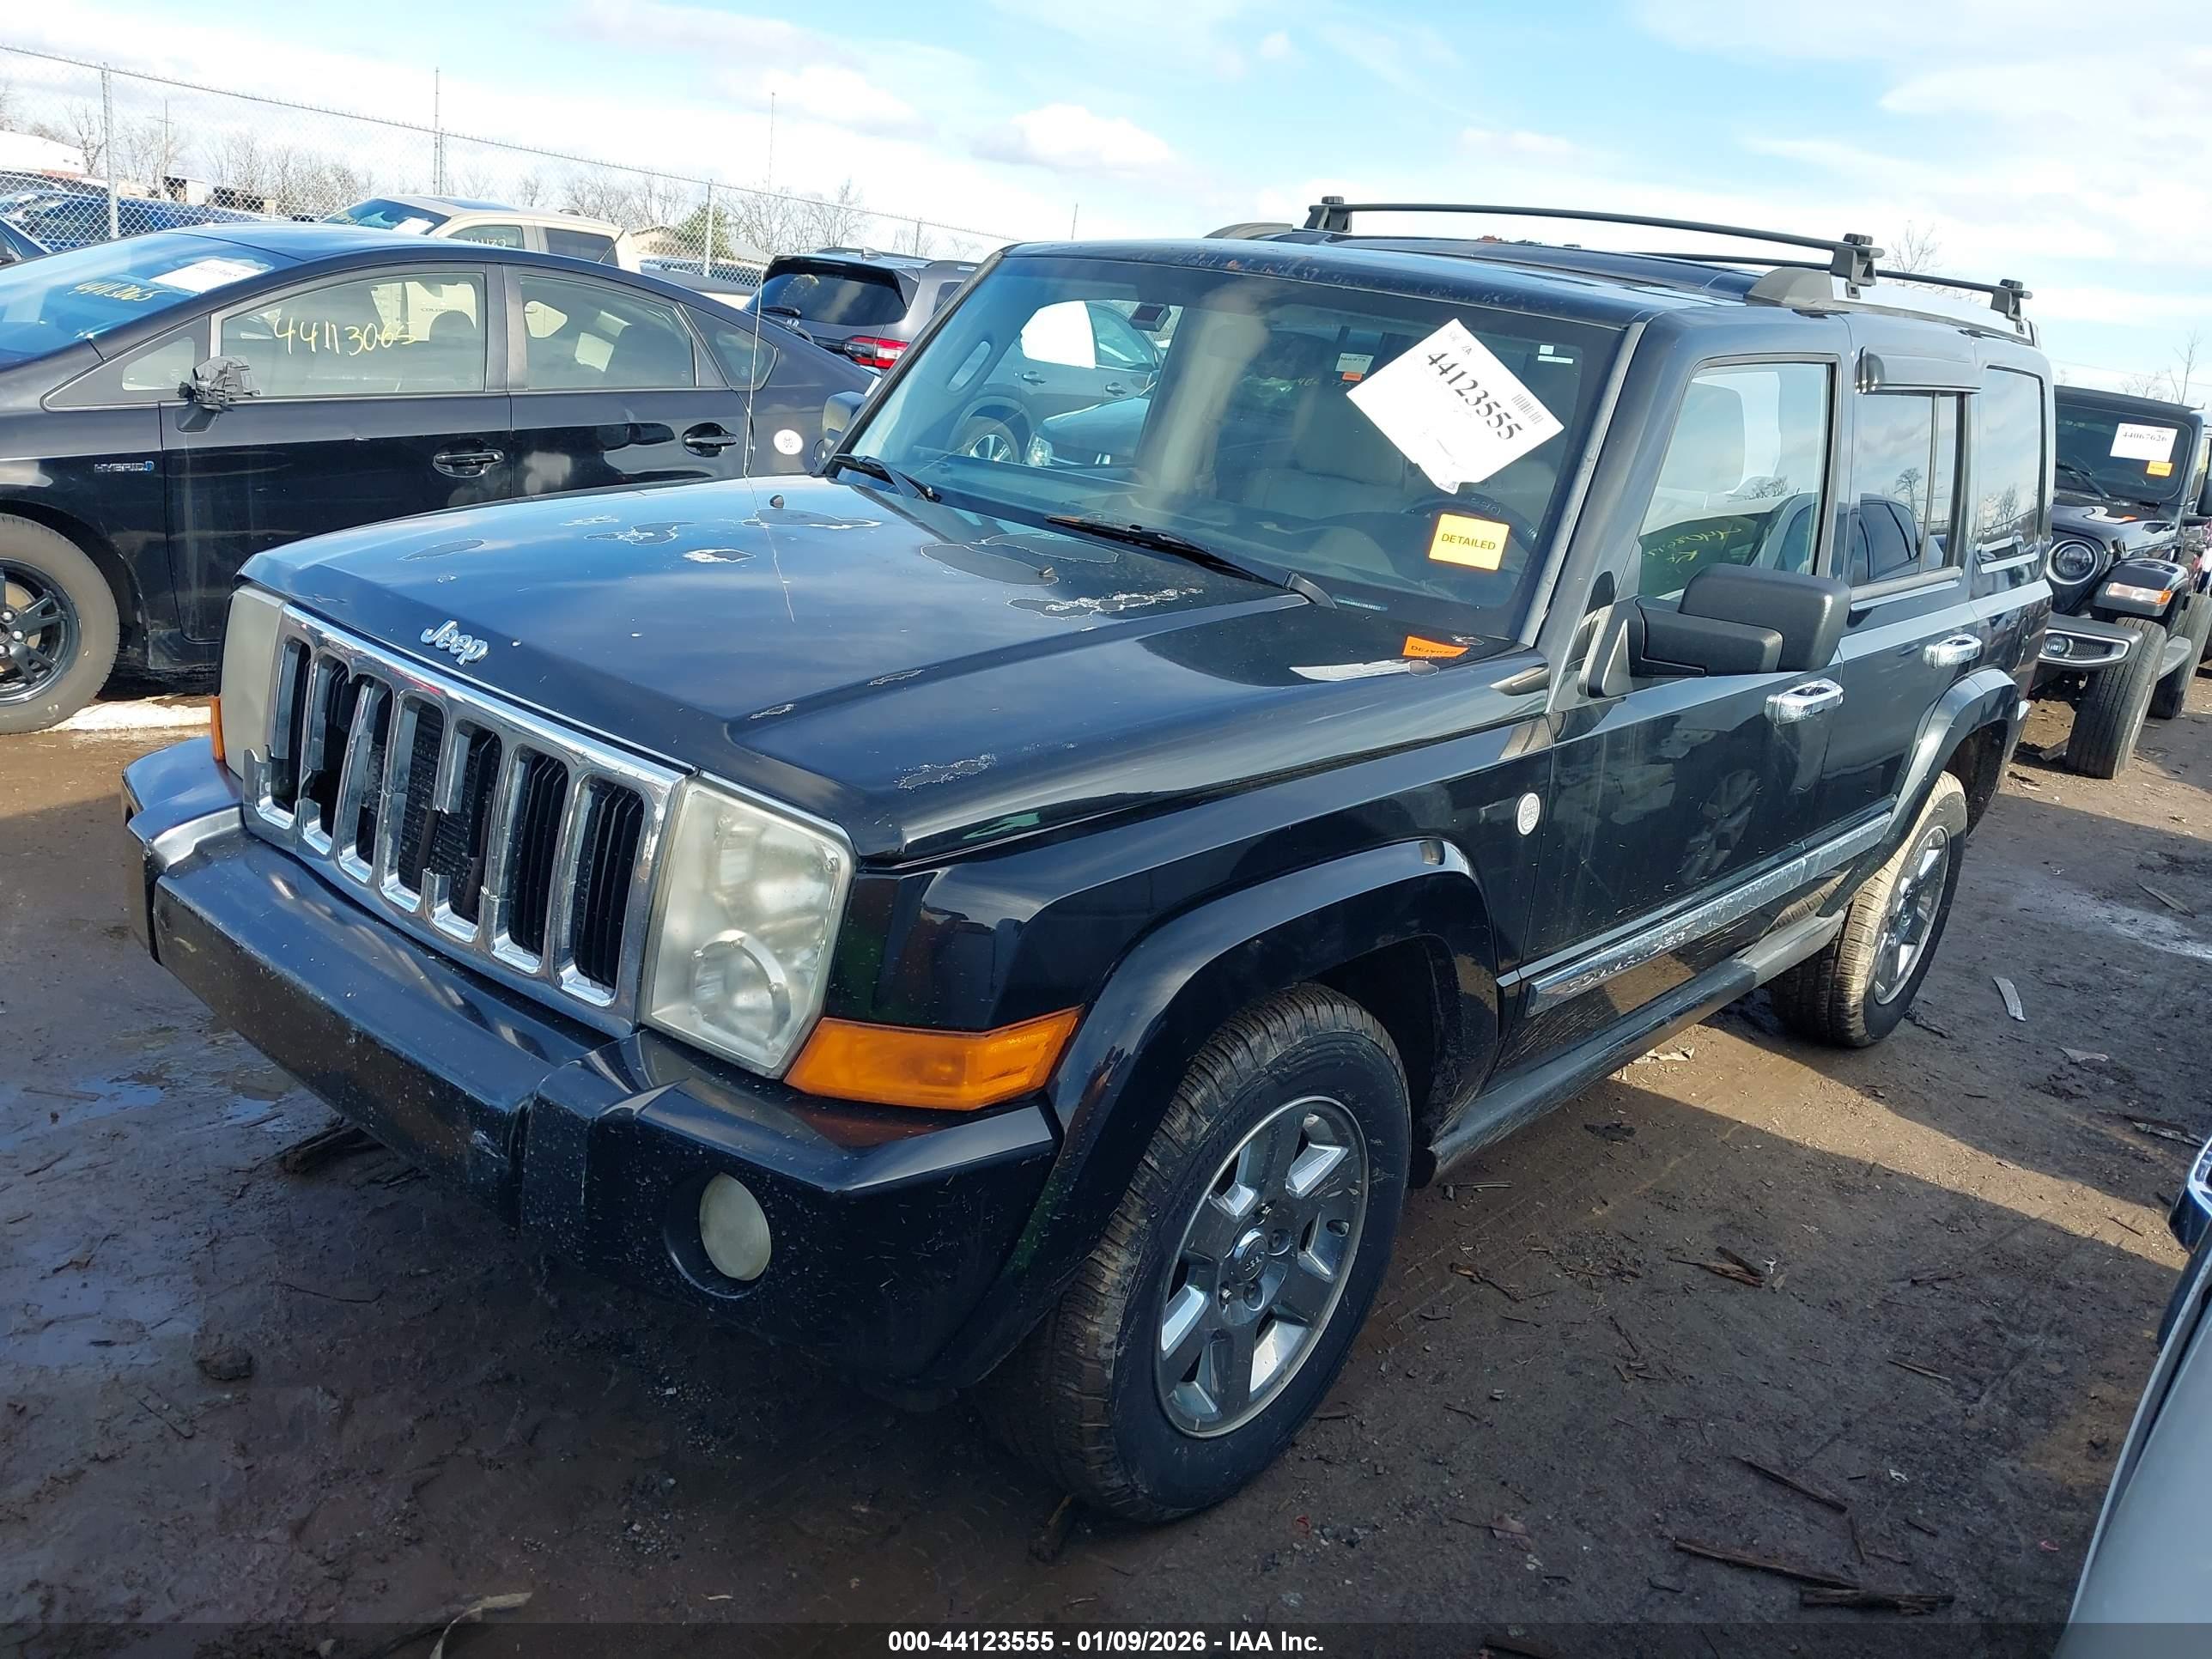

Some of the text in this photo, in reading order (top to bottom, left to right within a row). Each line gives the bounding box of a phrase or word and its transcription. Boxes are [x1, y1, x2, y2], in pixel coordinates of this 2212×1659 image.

[274, 317, 417, 356] 44113065
[1426, 349, 1523, 441] 44123555
[94, 462, 145, 473] HYBRID
[1441, 532, 1497, 551] DETAILED
[420, 619, 489, 666] Jeep
